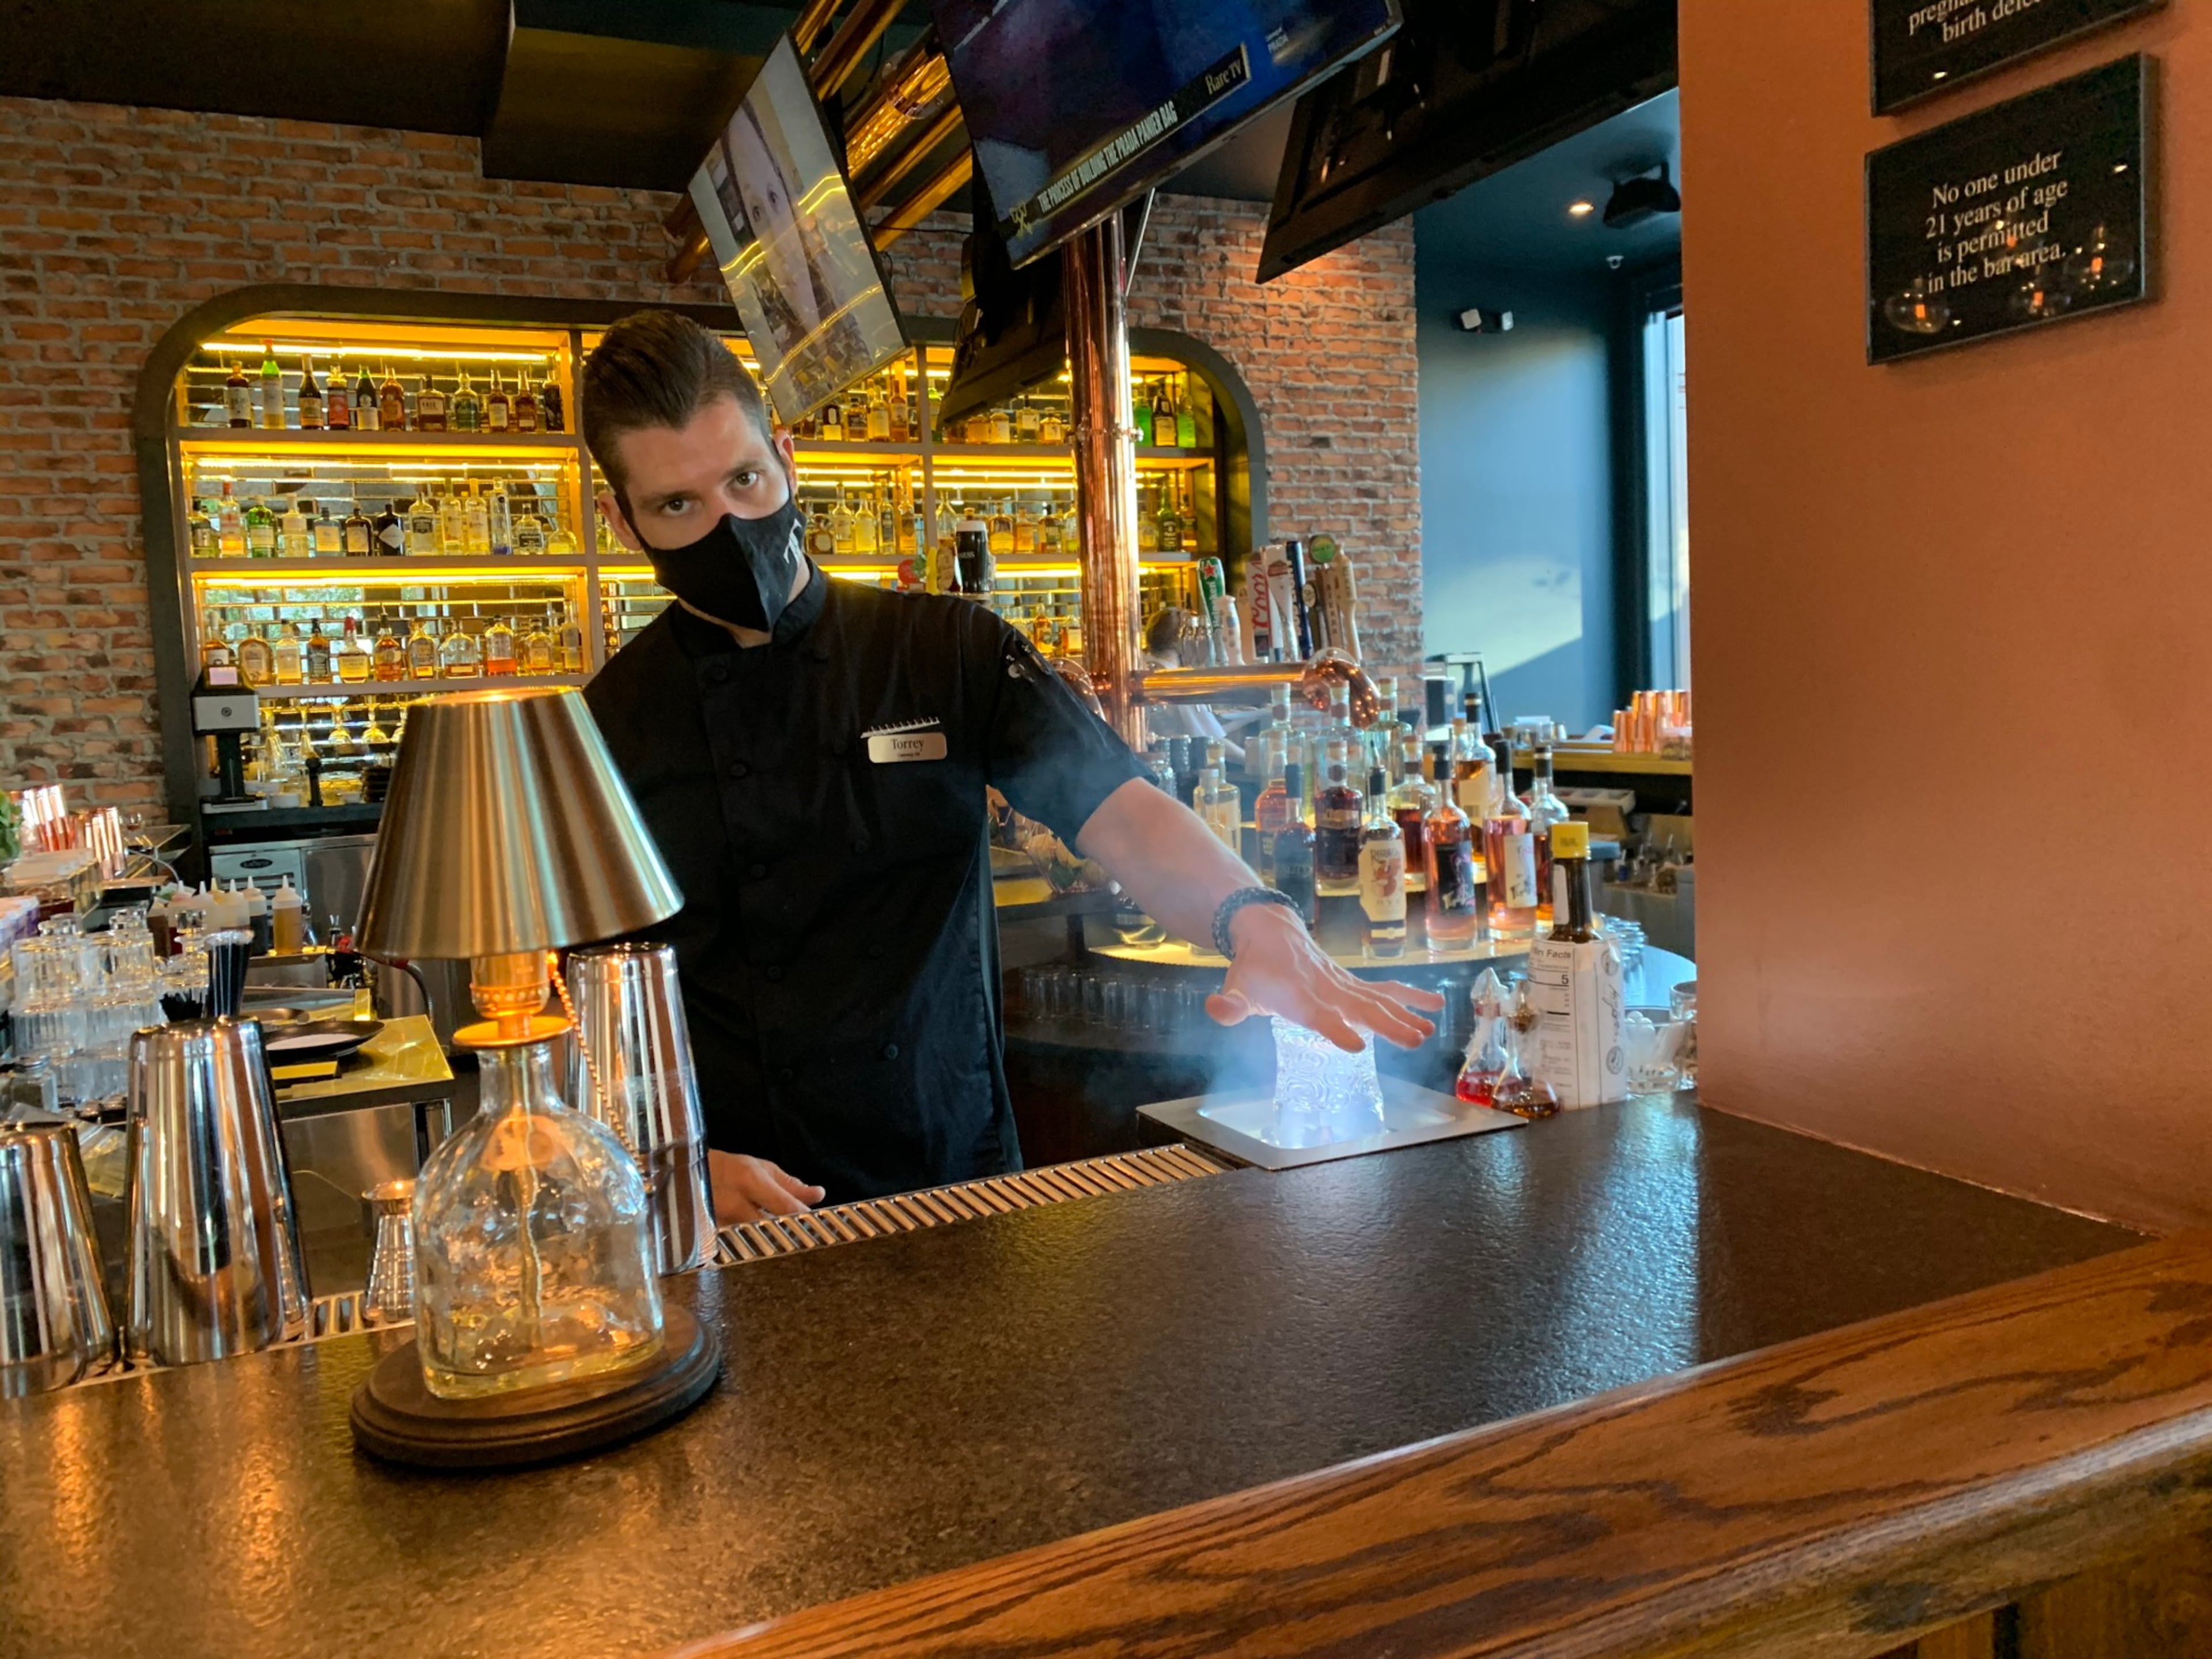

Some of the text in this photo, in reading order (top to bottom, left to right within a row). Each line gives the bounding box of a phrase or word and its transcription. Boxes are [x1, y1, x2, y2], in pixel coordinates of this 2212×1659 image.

[1942, 6, 1987, 43] birth
[1205, 59, 1242, 94] Rare TV
[1037, 191, 1052, 213] THE
[1070, 169, 1081, 191] OF
[1103, 142, 1119, 167] THE
[1115, 128, 1141, 160] PRADA
[1159, 100, 1178, 129] BAG
[1933, 150, 2063, 209] No one under
[1926, 180, 2068, 238] 21 years of age
[1938, 210, 2048, 263] is permitted
[1928, 243, 2066, 293] in the bar area.
[891, 738, 925, 751] Torrey
[1547, 949, 1571, 959] Facts
[1562, 974, 1569, 984] 5
